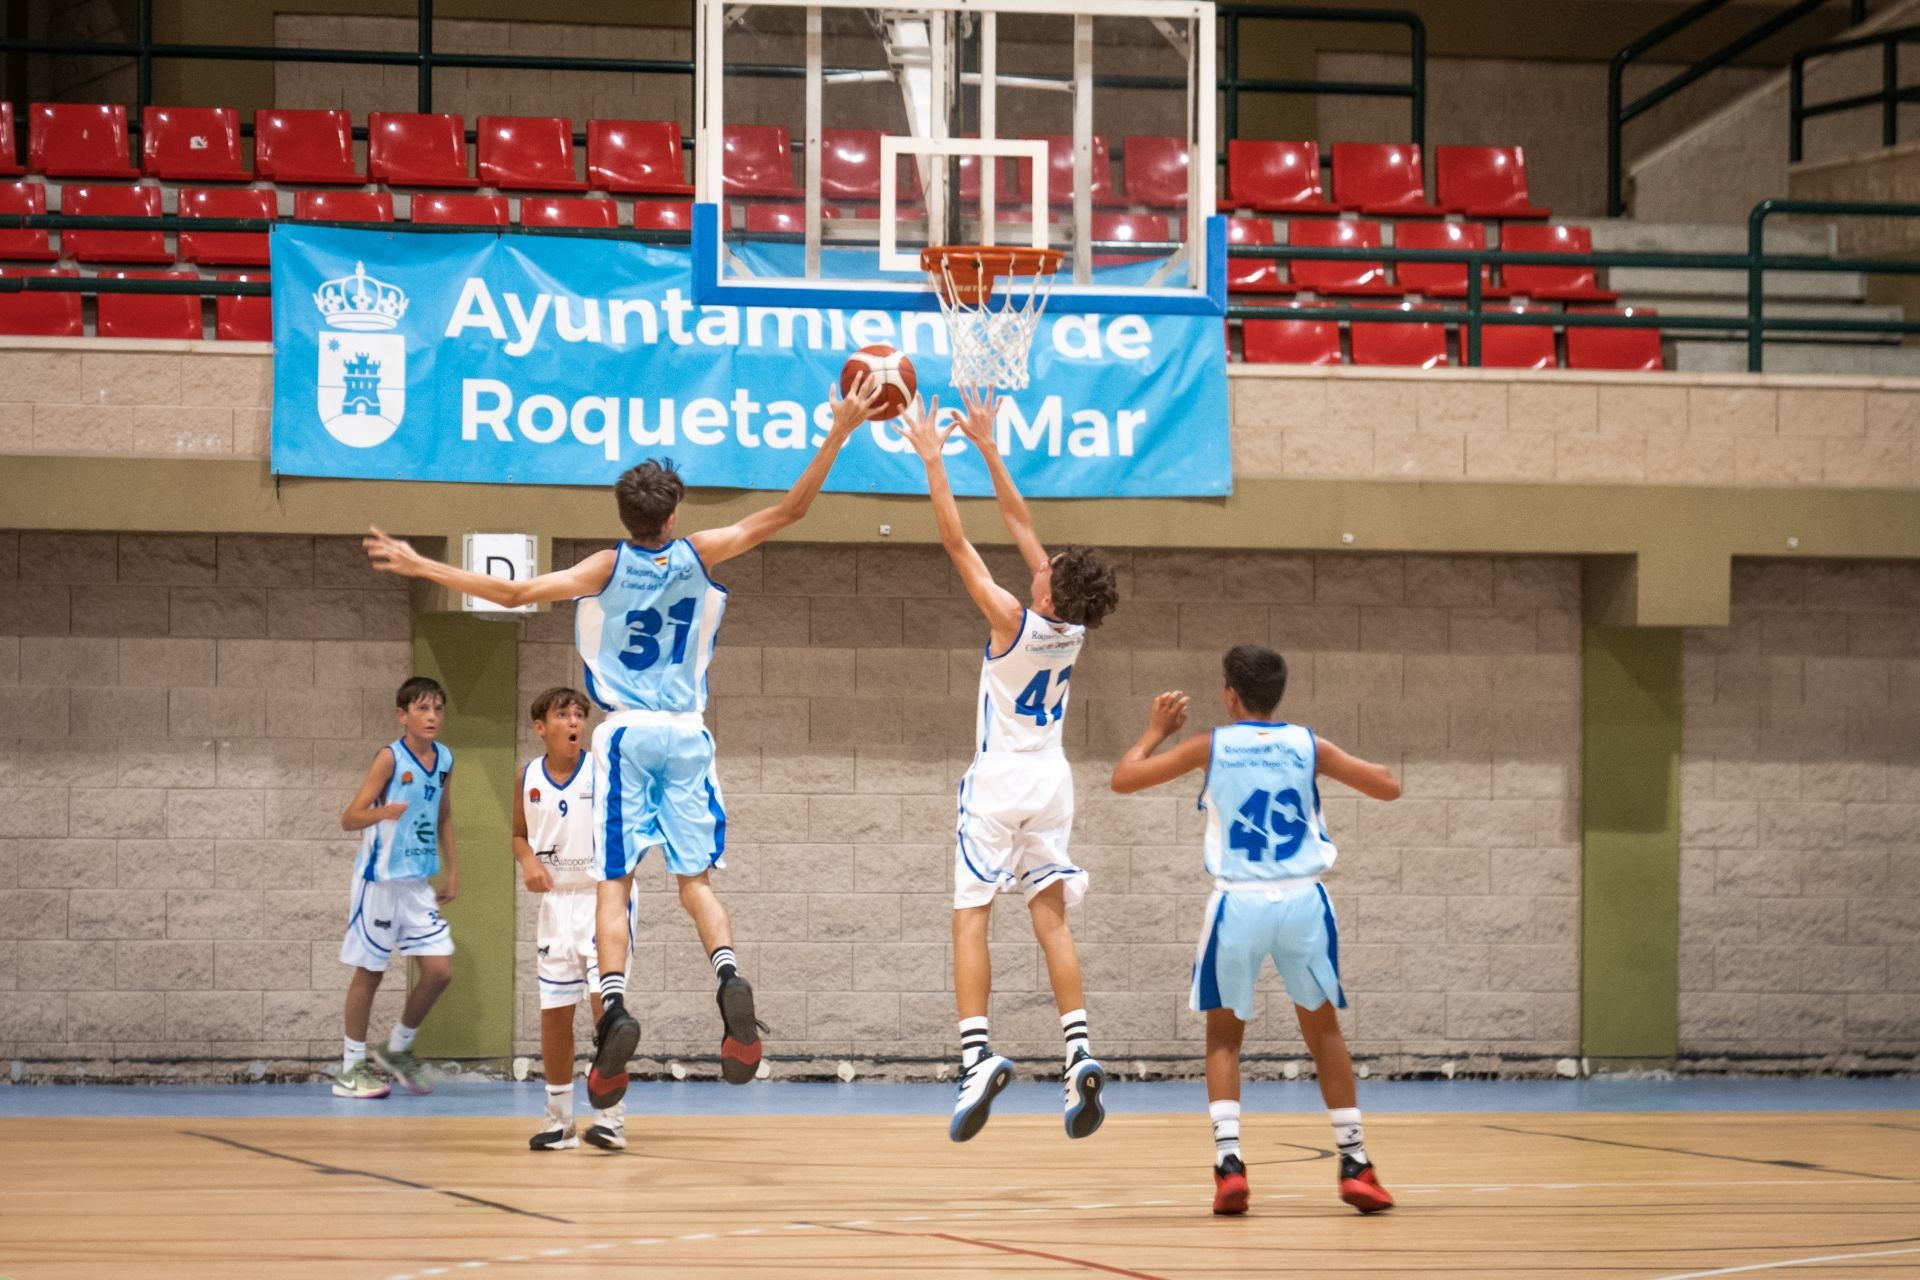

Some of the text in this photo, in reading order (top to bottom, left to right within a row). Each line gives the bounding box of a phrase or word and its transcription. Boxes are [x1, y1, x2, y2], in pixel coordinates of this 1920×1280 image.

[996, 395, 1147, 457] Mar
[618, 597, 697, 671] 31
[424, 784, 436, 802] 17
[559, 799, 568, 818] 9
[1229, 788, 1308, 861] 49
